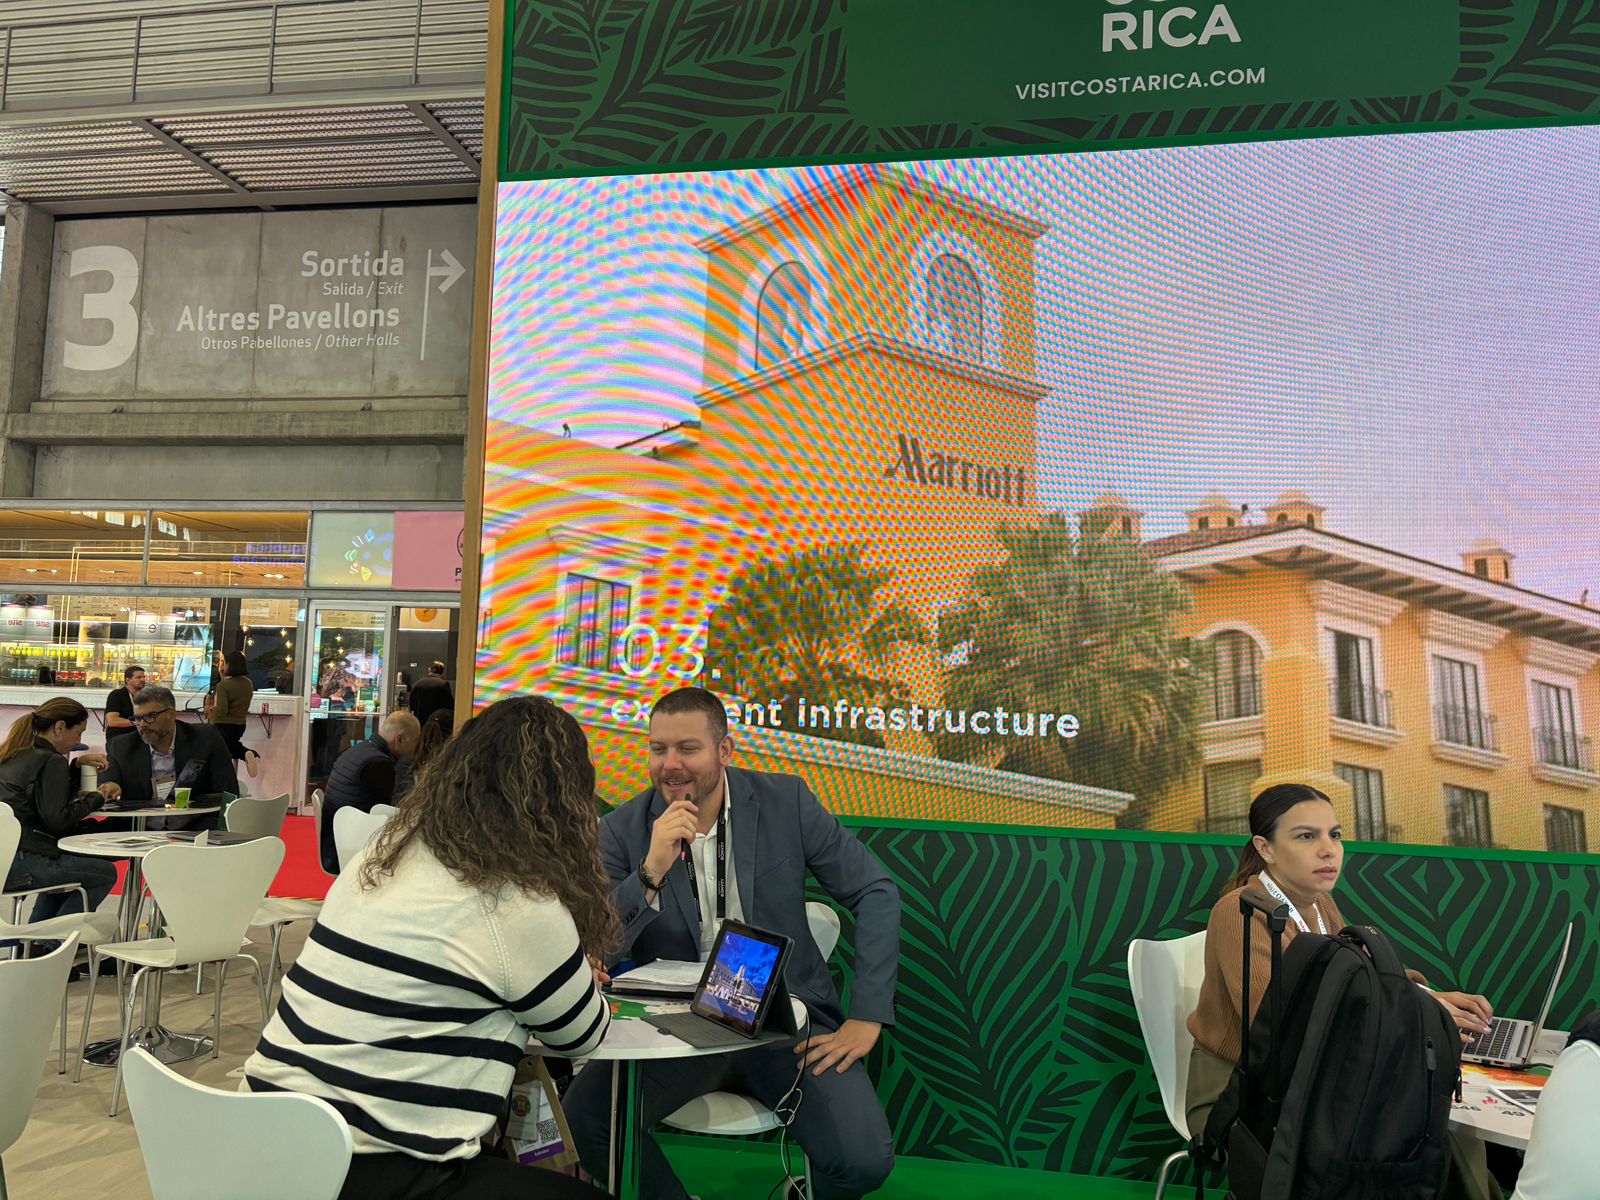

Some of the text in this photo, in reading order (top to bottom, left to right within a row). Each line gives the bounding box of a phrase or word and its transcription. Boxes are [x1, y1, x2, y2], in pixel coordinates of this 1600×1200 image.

[1101, 3, 1242, 53] RICA
[1015, 67, 1267, 100] VISITCOSTARICA.COM
[301, 250, 404, 277] Sortida
[323, 282, 364, 296] Salida
[377, 281, 404, 295] Exit
[62, 245, 140, 371] 3
[176, 302, 400, 332] Altres Pavellons
[201, 336, 238, 350] Otros
[241, 335, 312, 350] Pabellones
[325, 335, 364, 348] Other
[366, 332, 400, 346] Halls
[884, 433, 1025, 506] Marriott
[616, 623, 721, 679] 03.
[611, 697, 1080, 738] exent infrastructure
